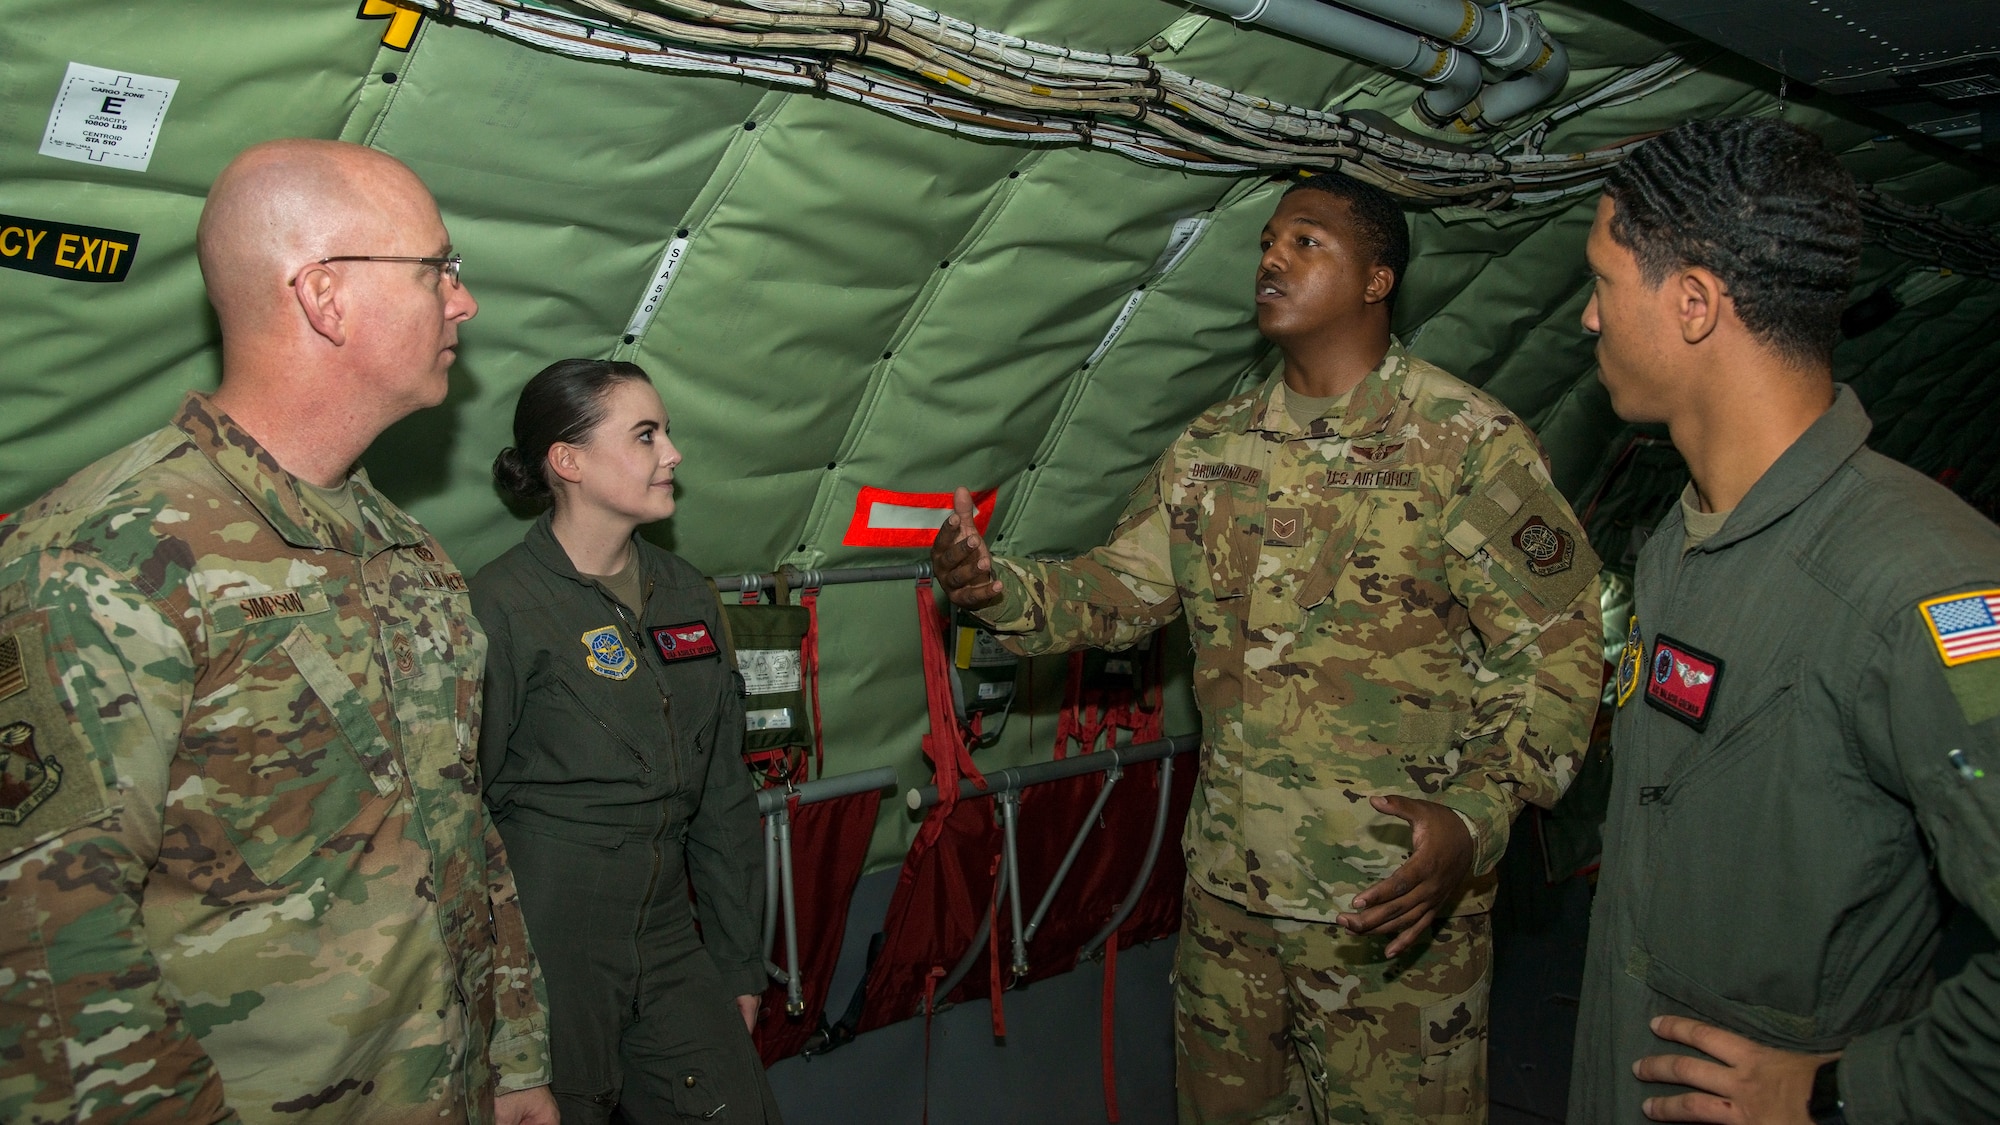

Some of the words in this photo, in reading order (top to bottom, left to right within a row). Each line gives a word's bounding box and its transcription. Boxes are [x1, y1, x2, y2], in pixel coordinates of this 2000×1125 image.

[91, 86, 121, 96] CARGO
[122, 91, 145, 99] ZONE
[100, 96, 126, 115] E
[84, 119, 110, 128] 10800
[111, 123, 128, 131] LBS
[88, 114, 127, 125] CAPACITY
[82, 130, 123, 141] CENTROID
[85, 136, 100, 144] STA
[102, 139, 117, 147] 510
[0, 226, 48, 261] CY
[55, 233, 129, 275] EXIT
[660, 248, 681, 280] STA
[644, 284, 664, 313] 540
[1242, 470, 1260, 485] JR
[1326, 469, 1349, 486] U.S.
[1352, 471, 1374, 487] AIR
[1375, 470, 1416, 487] FORCE
[239, 592, 306, 621] SIMPSON
